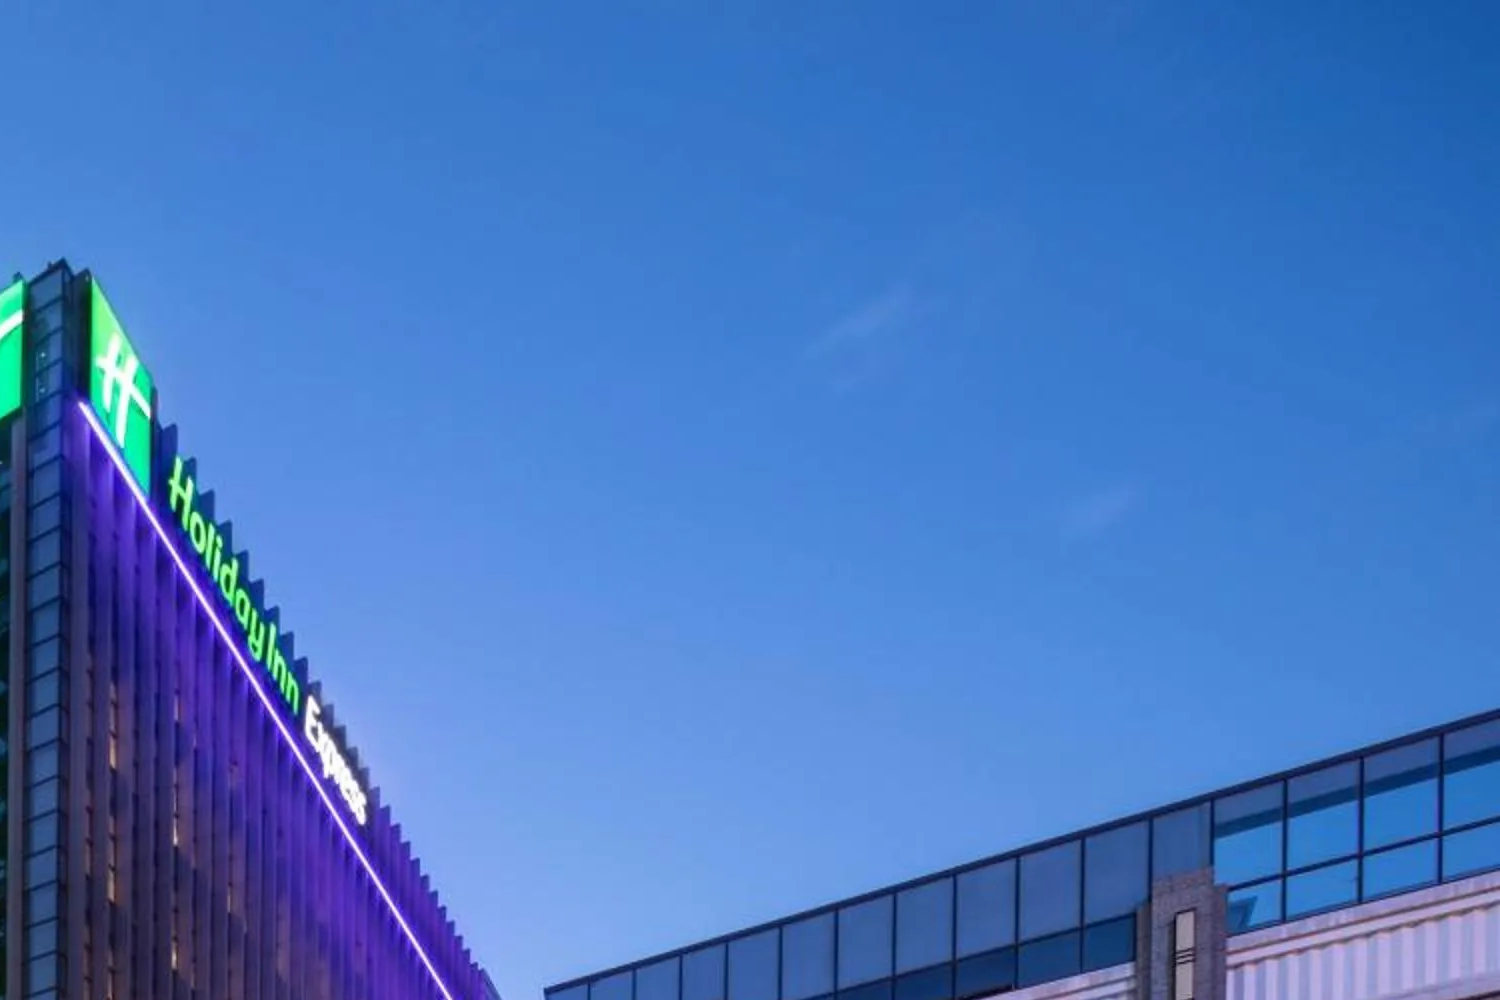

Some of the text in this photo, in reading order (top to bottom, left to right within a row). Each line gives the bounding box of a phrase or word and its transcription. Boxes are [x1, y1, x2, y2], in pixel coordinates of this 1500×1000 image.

[169, 456, 367, 826] Holiday Inn Express
